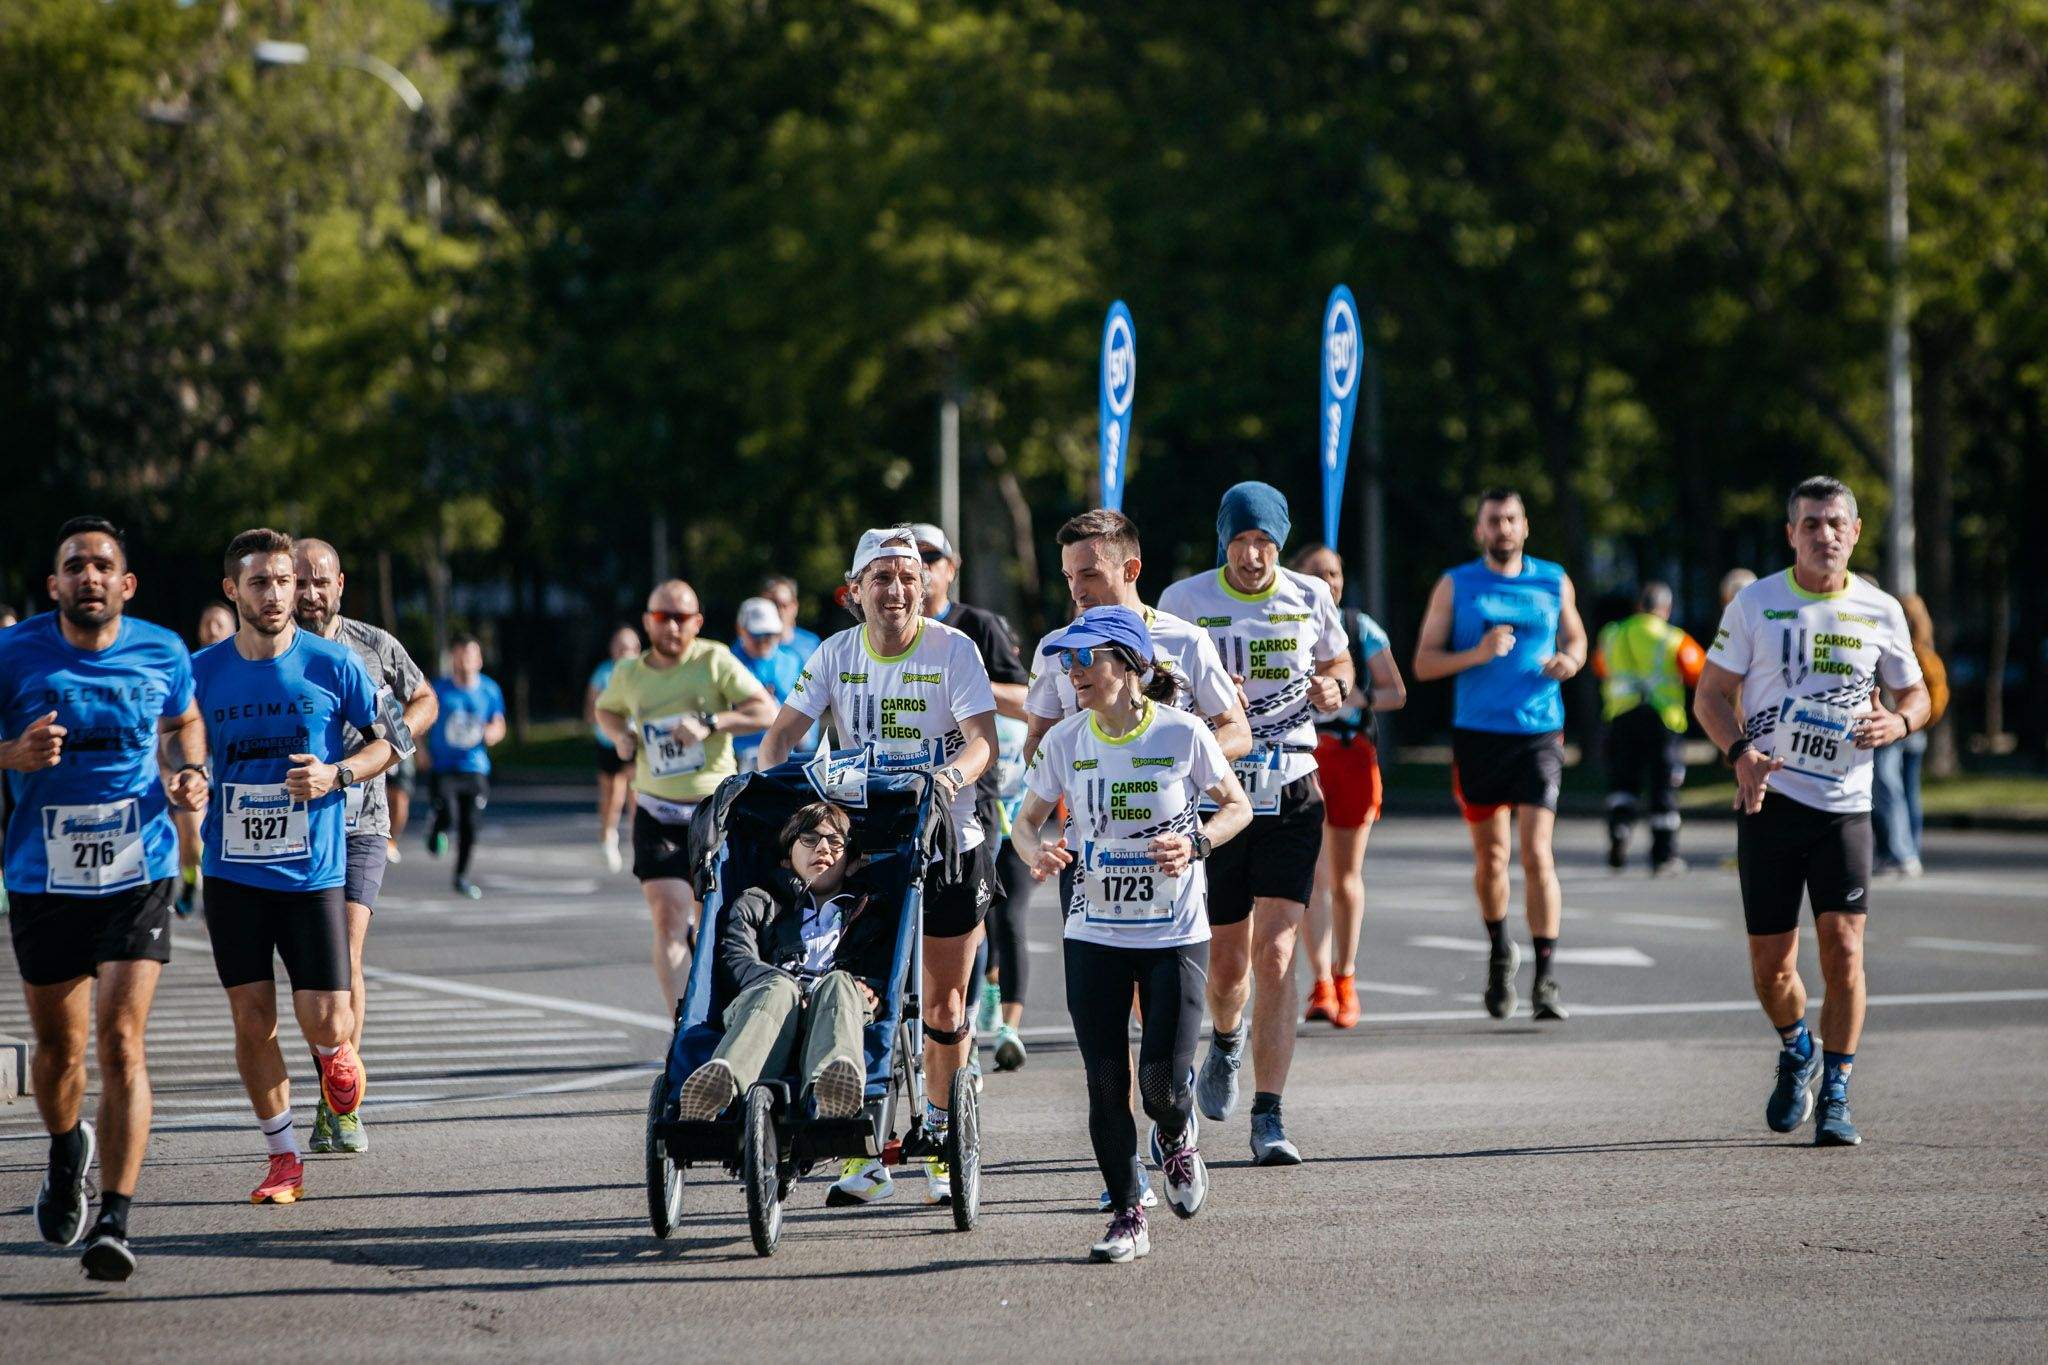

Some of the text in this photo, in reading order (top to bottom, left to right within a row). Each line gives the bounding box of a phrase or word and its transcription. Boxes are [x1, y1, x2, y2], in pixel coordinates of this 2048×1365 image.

[1249, 639, 1297, 653] CARROS
[1814, 633, 1863, 650] CARROS
[1814, 647, 1832, 659] DE
[1250, 655, 1267, 668] DE
[1813, 660, 1854, 676] FUEGO
[1250, 668, 1290, 680] FUEGO
[44, 686, 160, 706] DECIMAS
[881, 698, 927, 712] CARROS
[214, 701, 314, 724] DECIMAS
[881, 712, 896, 725] DE
[881, 726, 922, 740] FUEGO
[1790, 731, 1840, 762] 1185
[887, 749, 929, 761] BOMBEROS
[1233, 761, 1265, 770] CIMAS
[1111, 780, 1158, 795] CARROS
[1111, 796, 1127, 808] DE
[245, 807, 289, 816] DECIMAS
[1111, 808, 1152, 821] FUEGO
[241, 815, 289, 841] 1327
[72, 840, 115, 869] 276
[1109, 851, 1151, 860] BOMBER
[1105, 865, 1155, 875] DECIMAS
[1101, 875, 1154, 903] 1723
